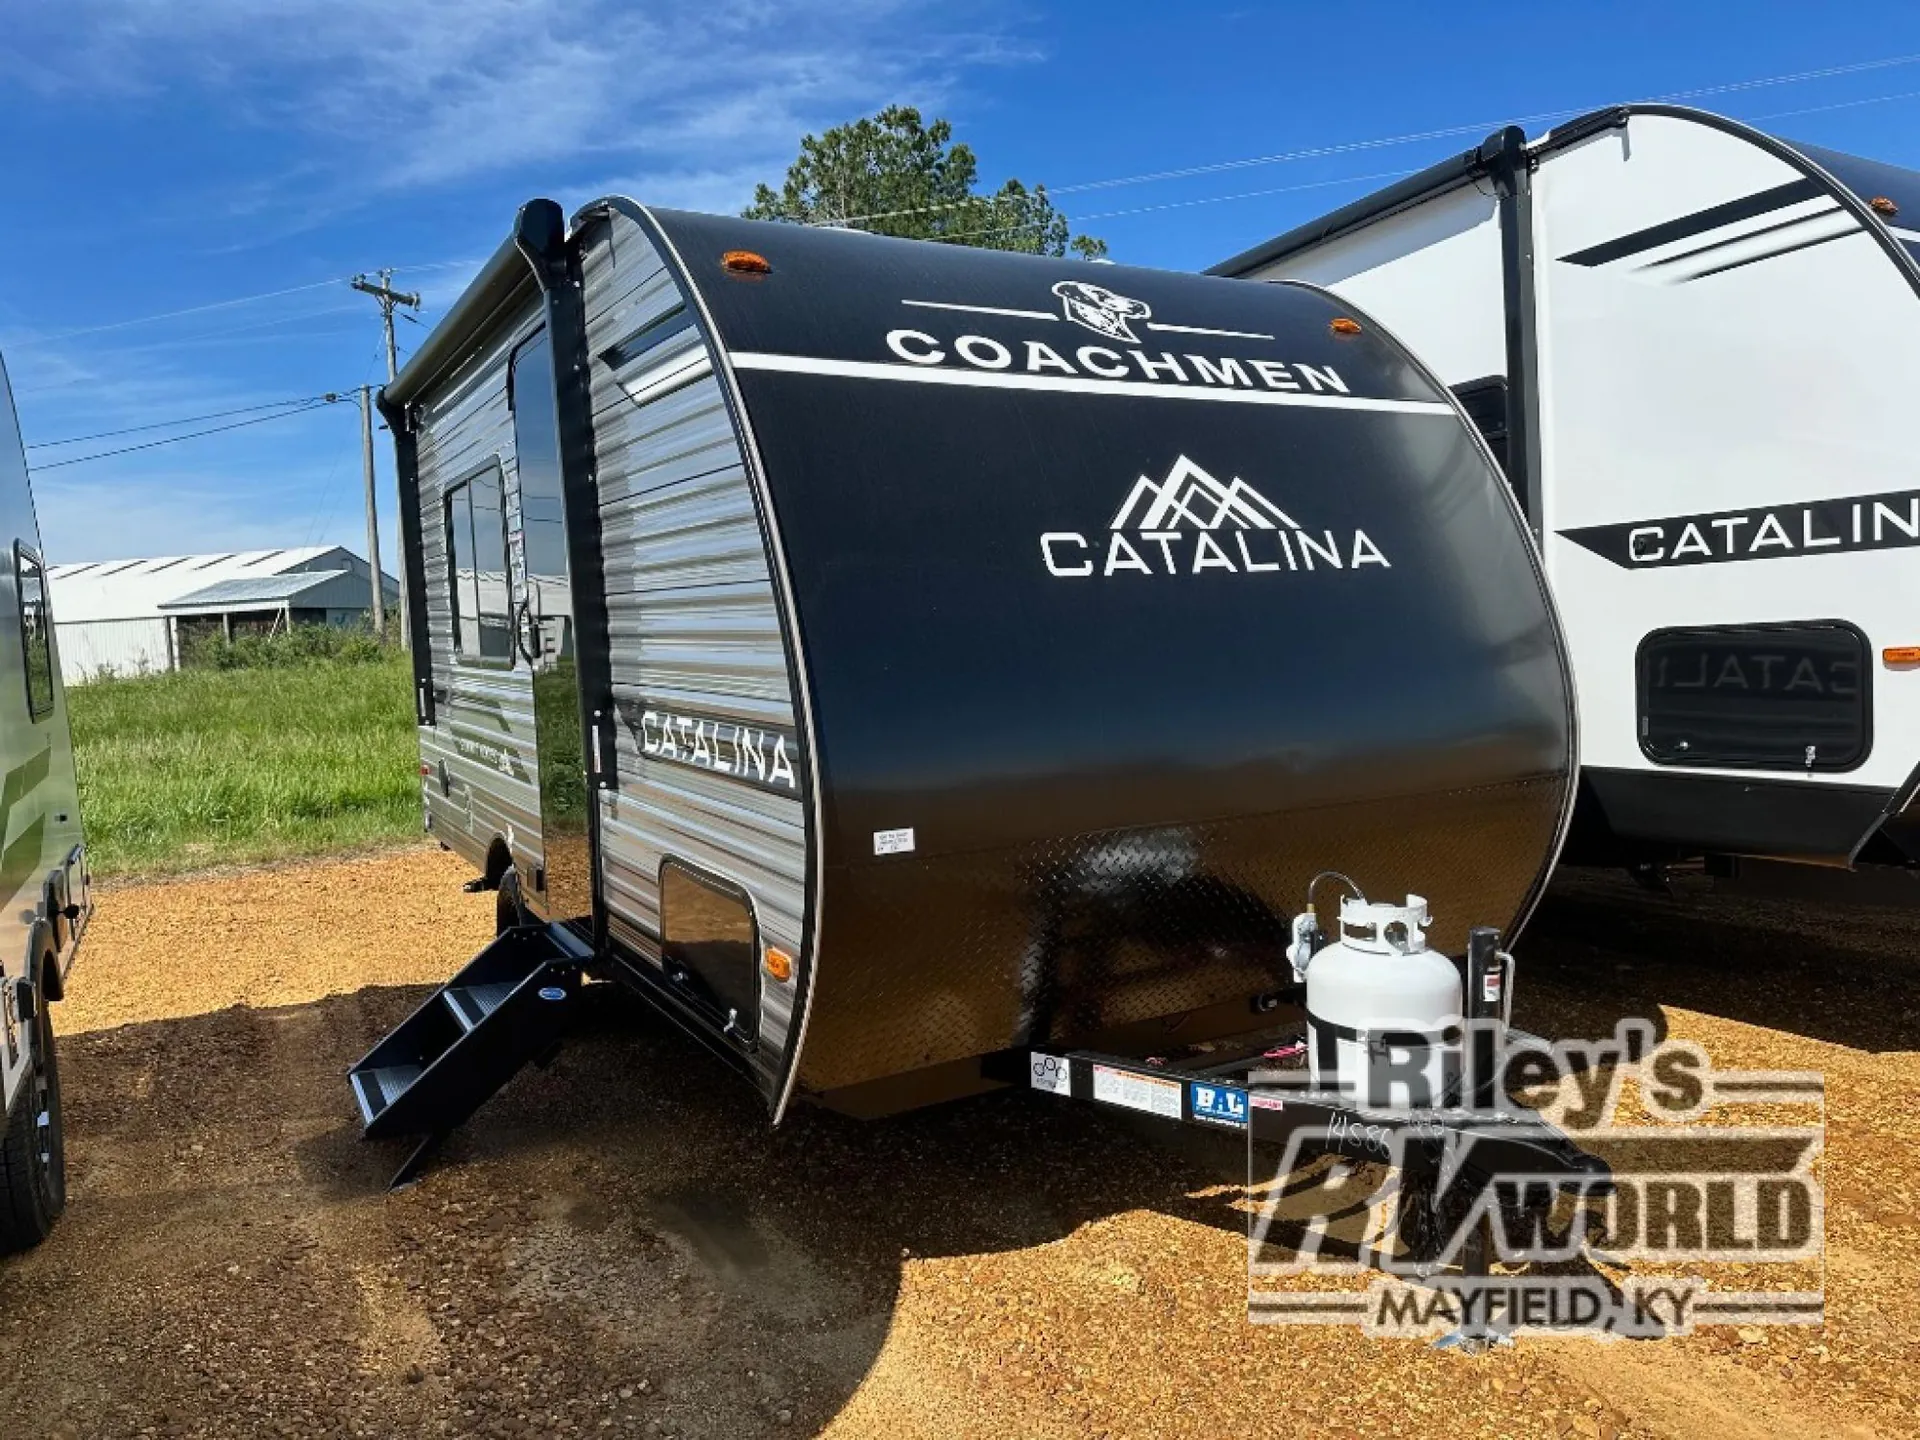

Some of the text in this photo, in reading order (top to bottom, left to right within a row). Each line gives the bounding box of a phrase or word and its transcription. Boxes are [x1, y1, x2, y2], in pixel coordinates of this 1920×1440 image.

[886, 328, 1351, 394] COACHMEN
[1039, 528, 1392, 577] CATALINA
[1628, 497, 1920, 562] CATALIN
[641, 710, 796, 789] CATALINA
